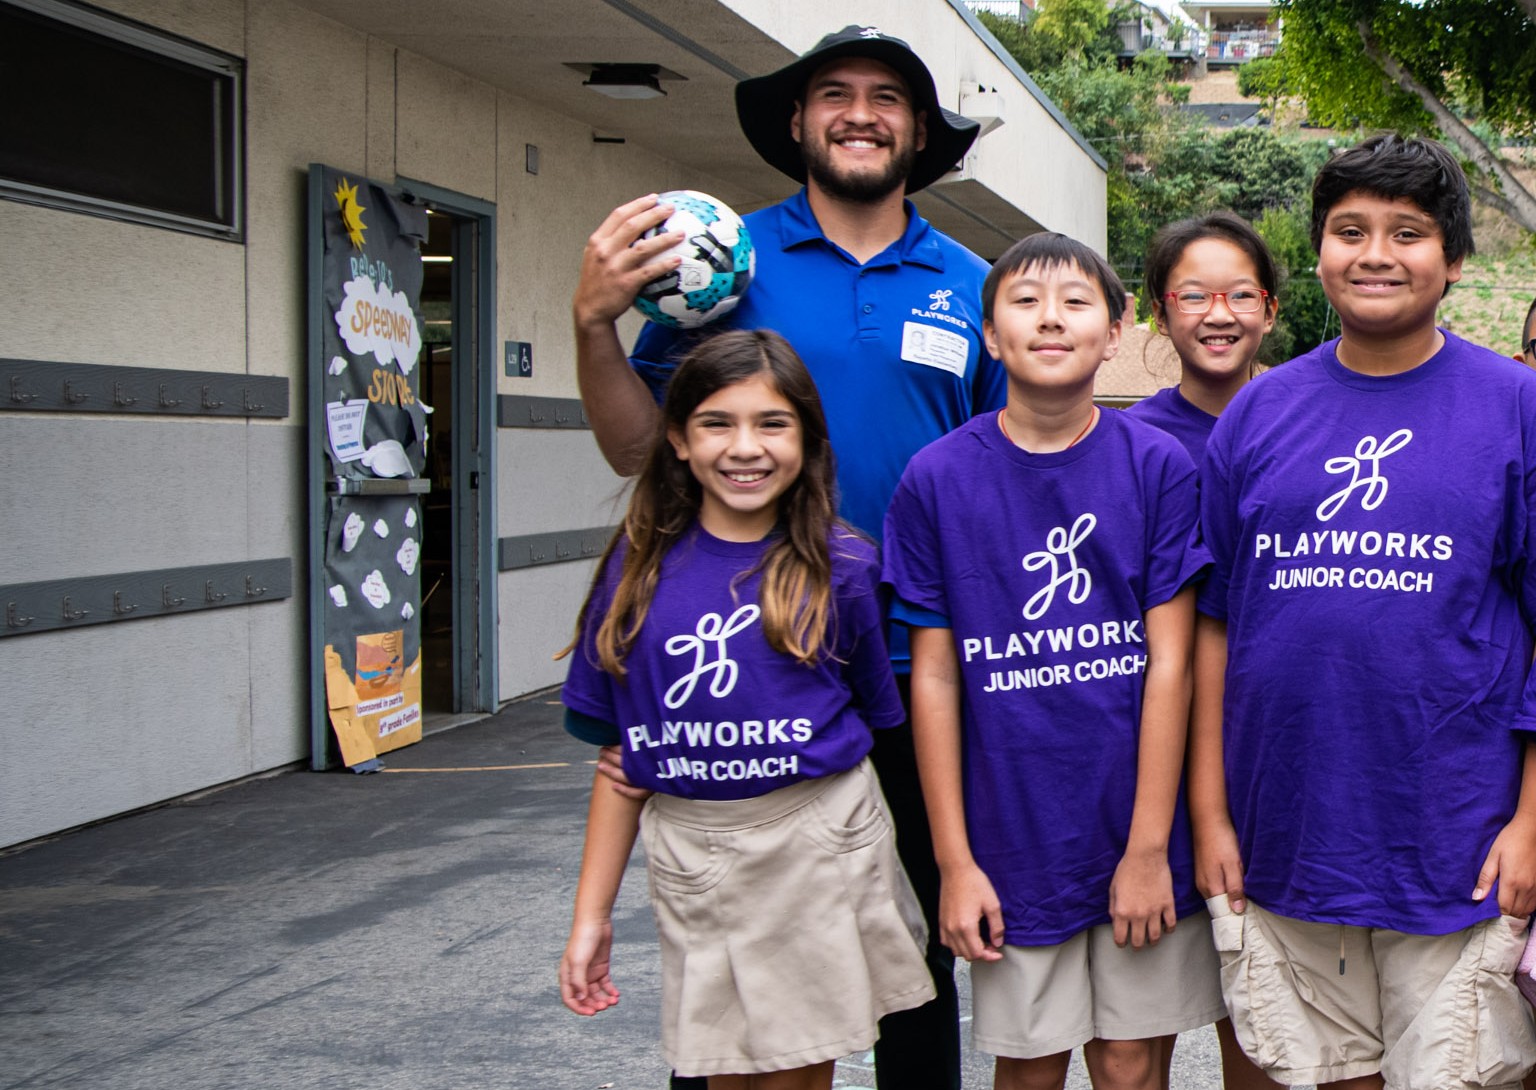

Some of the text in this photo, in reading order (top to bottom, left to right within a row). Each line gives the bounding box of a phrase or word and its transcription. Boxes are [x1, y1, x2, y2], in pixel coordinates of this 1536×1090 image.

[911, 308, 968, 329] PLAYWORKS
[1255, 530, 1453, 561] PLAYWORKS
[1269, 567, 1433, 592] JUNIOR COACH
[962, 620, 1146, 662] PLAYWORK
[983, 654, 1148, 693] JUNIOR COACH
[710, 755, 798, 781] COACH
